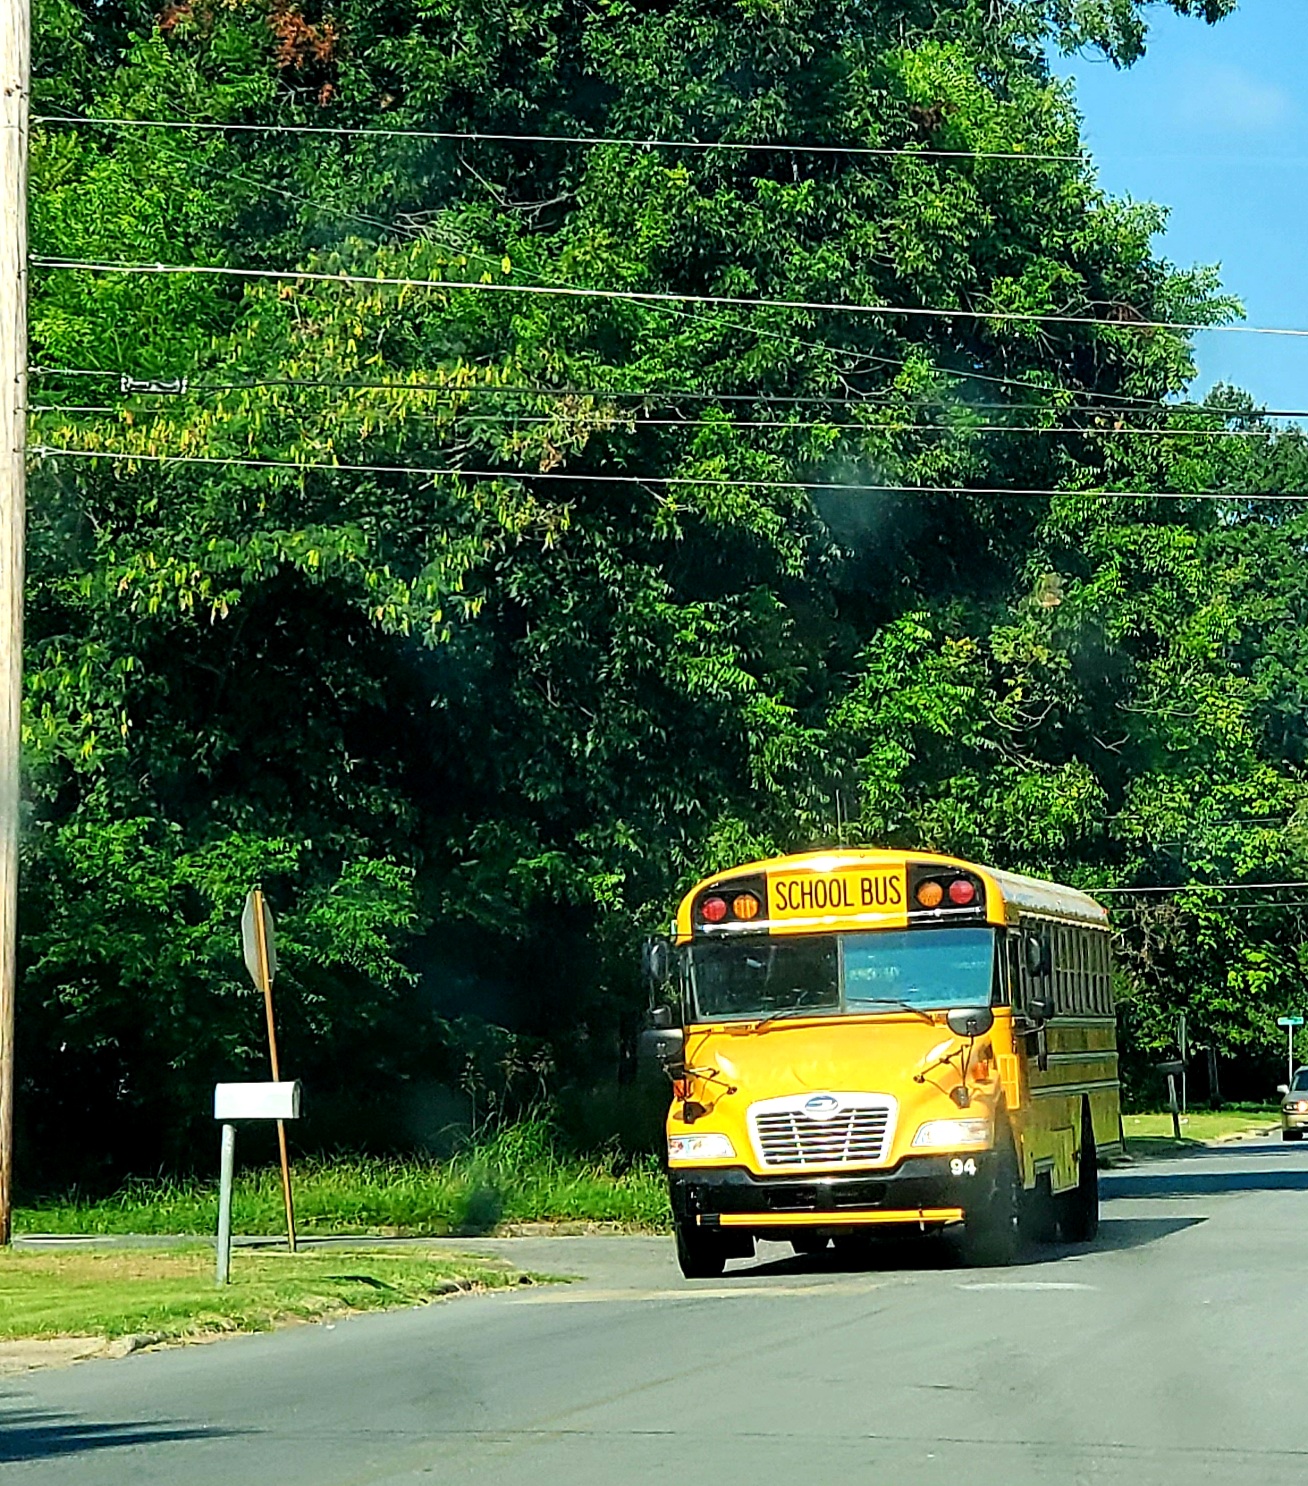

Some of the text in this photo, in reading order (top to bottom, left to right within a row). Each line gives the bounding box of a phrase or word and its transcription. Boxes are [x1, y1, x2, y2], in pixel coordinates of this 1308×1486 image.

[775, 875, 902, 911] SCHOOL BUS
[950, 1158, 977, 1176] 94
